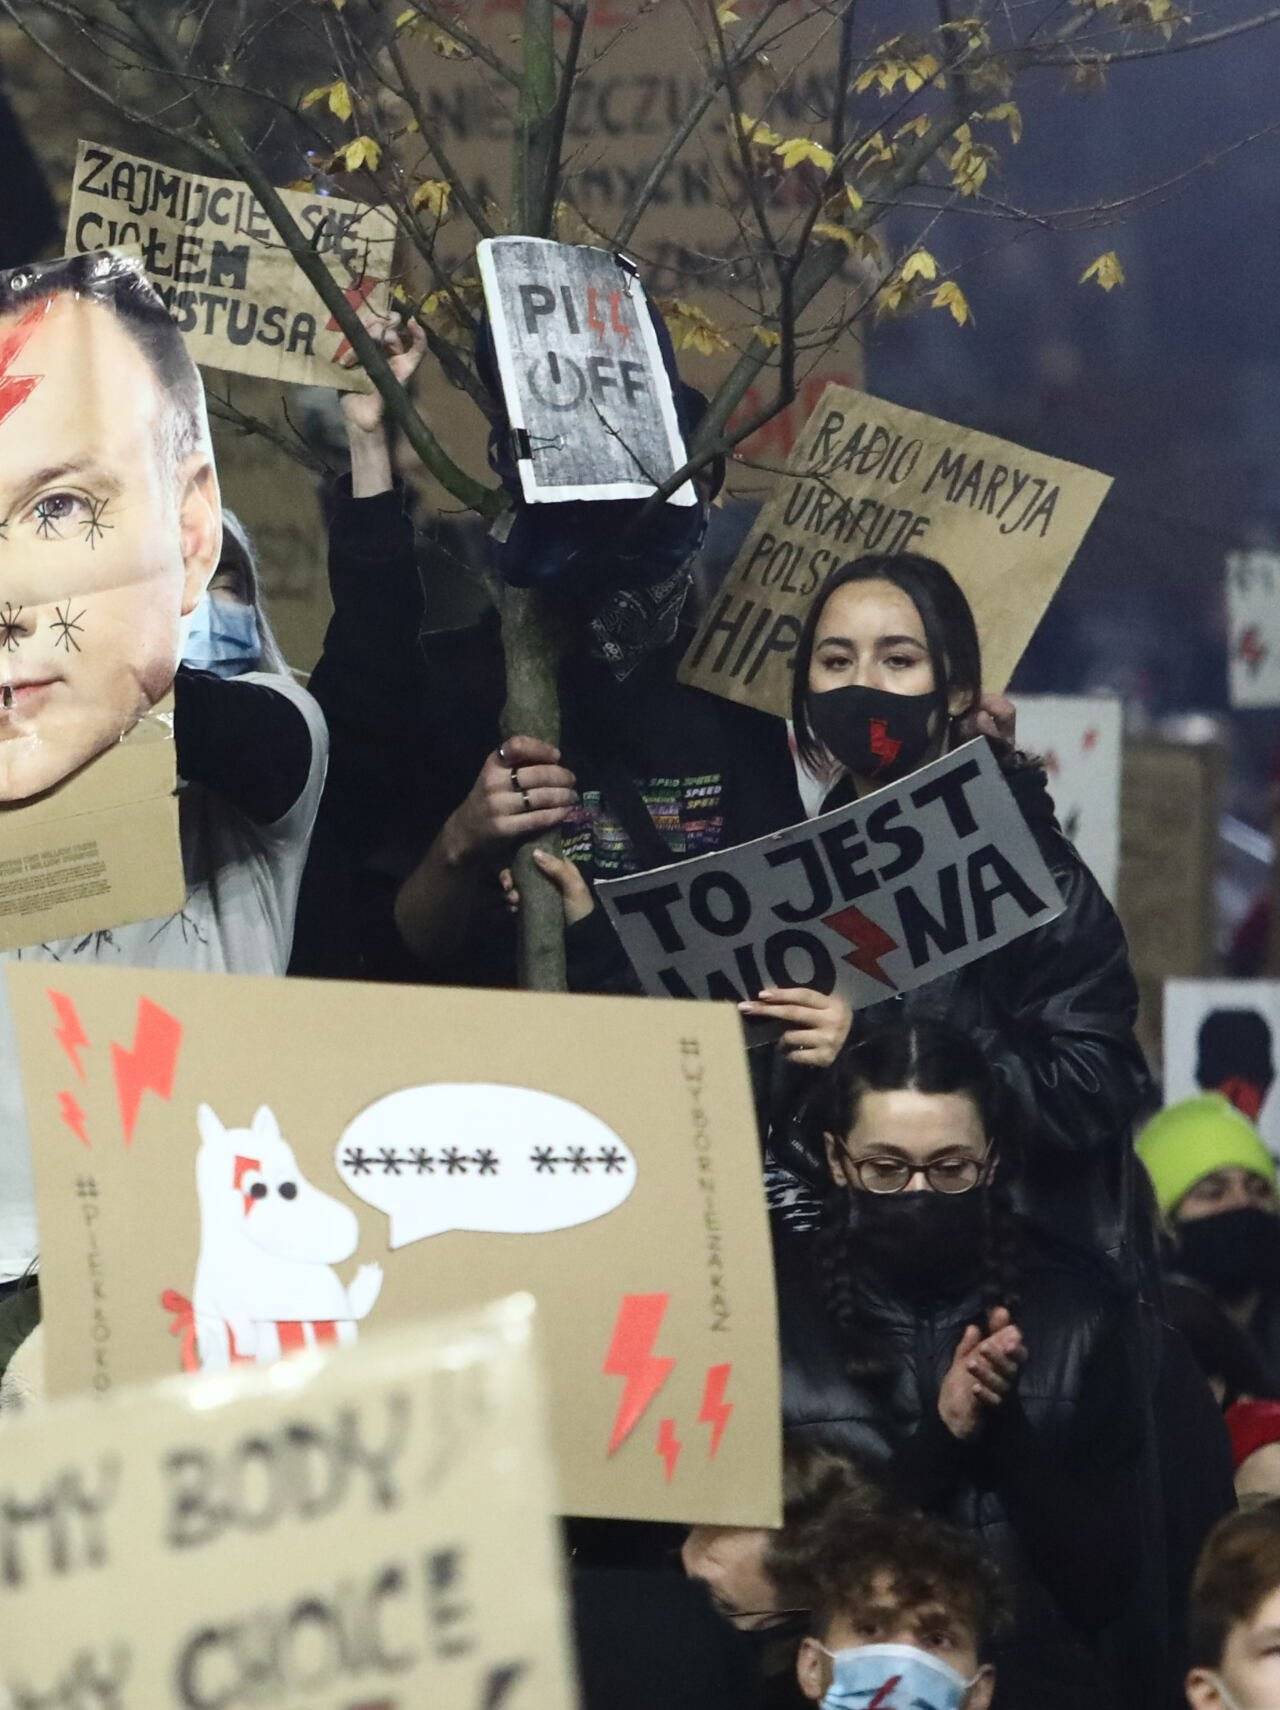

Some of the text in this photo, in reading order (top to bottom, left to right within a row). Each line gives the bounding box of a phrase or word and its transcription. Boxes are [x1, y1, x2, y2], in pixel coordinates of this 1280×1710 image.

[78, 150, 271, 240] ZAJMIJCIE
[518, 284, 630, 347] PILL
[527, 350, 648, 413] OFF
[782, 482, 931, 555] URATUJE
[807, 410, 926, 485] RADIO
[922, 446, 1062, 538] MARYJA
[741, 532, 841, 596] POLS
[689, 593, 803, 686] HIP
[612, 870, 752, 954] TO
[763, 758, 983, 924] JEST
[161, 1388, 414, 1552] BODY
